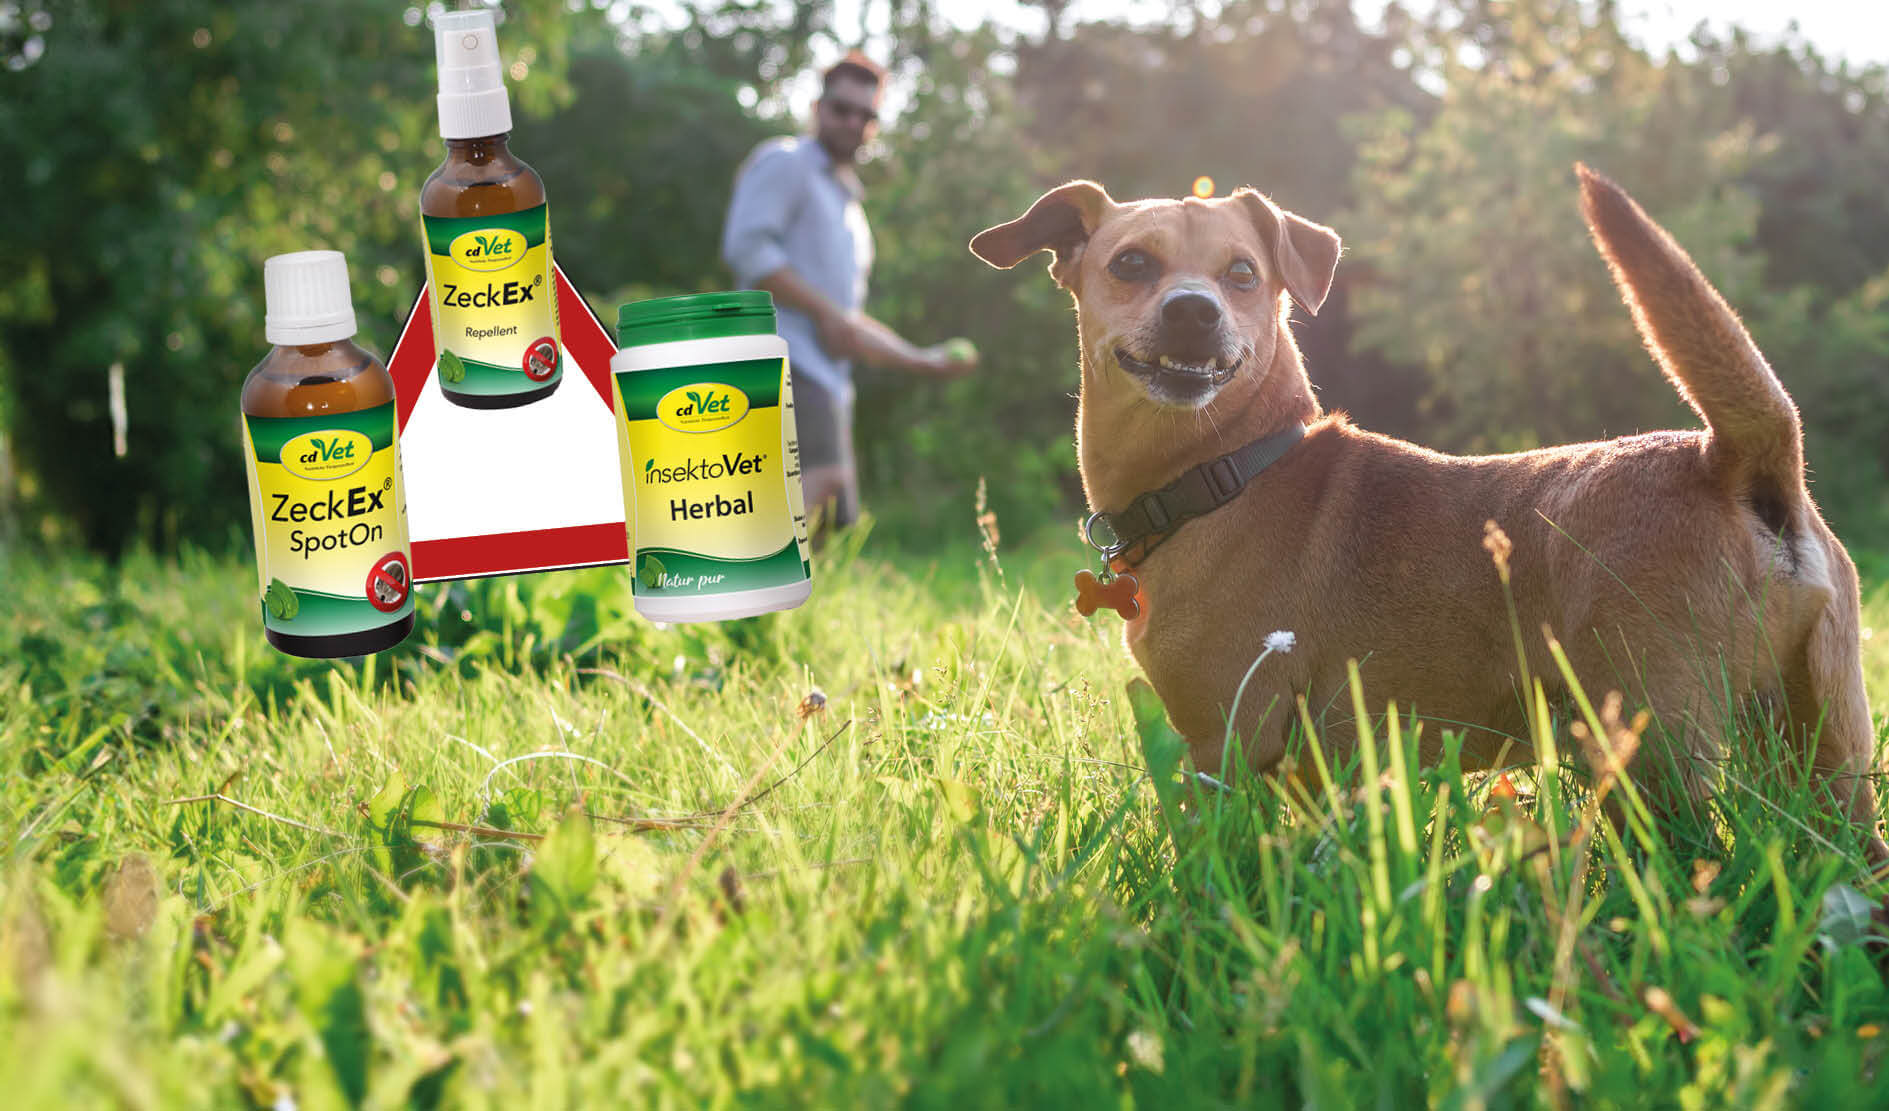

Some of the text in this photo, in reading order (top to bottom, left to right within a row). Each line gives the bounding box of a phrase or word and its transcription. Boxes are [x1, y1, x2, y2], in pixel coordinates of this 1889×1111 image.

[465, 325, 518, 340] Repellent
[670, 491, 754, 521] Herbal
[290, 523, 383, 560] SpotOn
[656, 572, 726, 591] Natur pur
